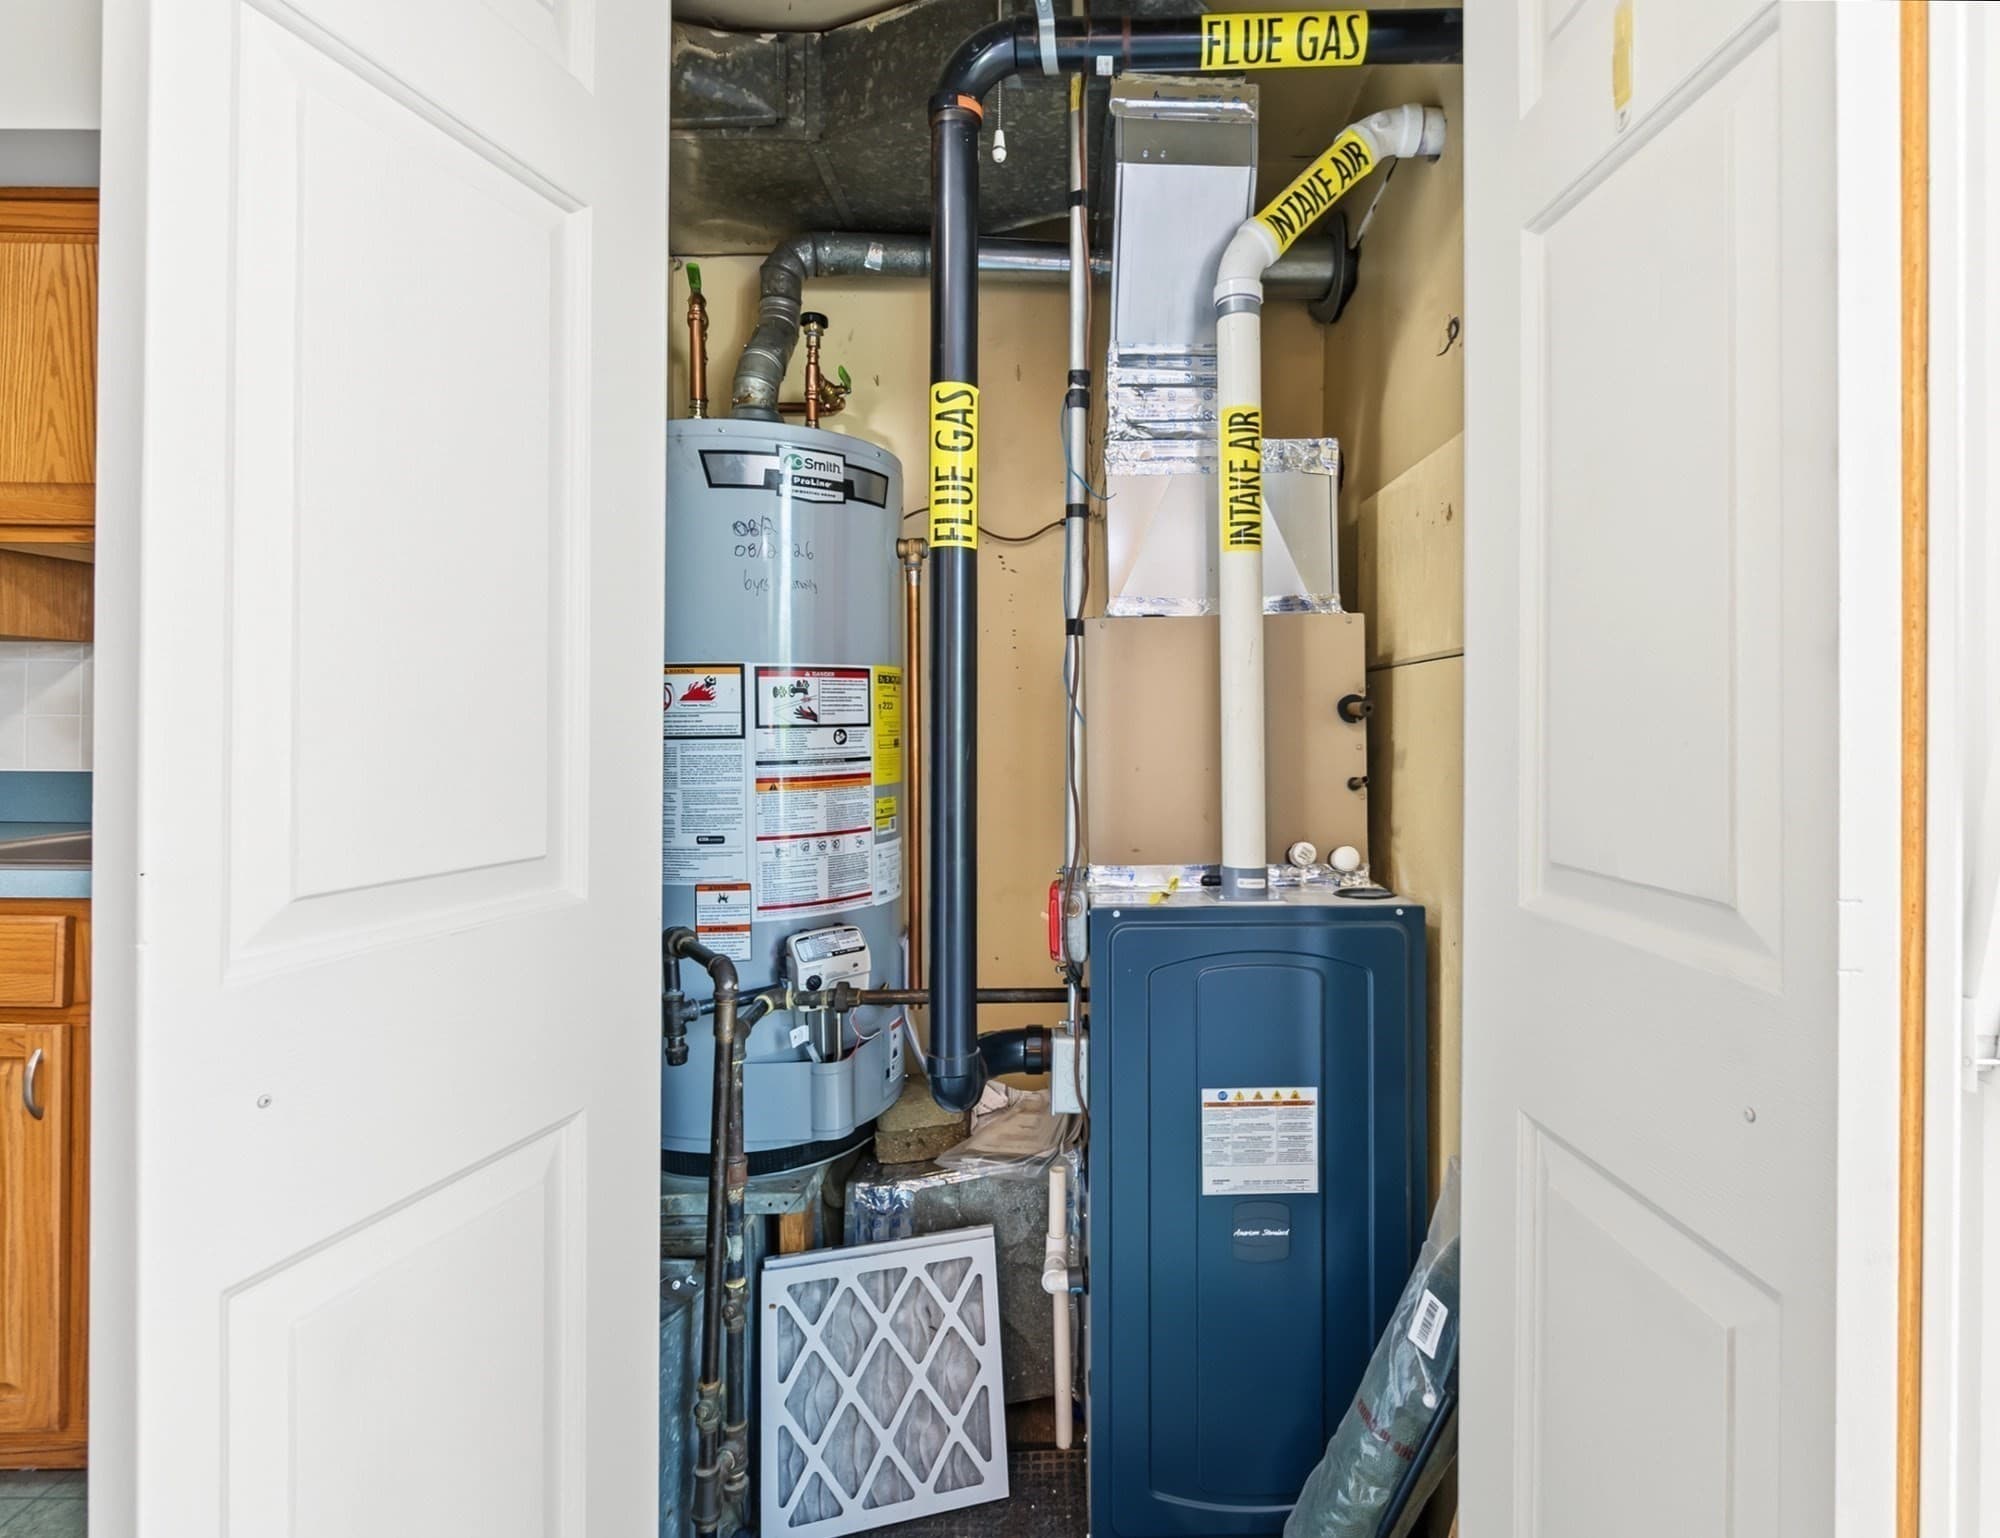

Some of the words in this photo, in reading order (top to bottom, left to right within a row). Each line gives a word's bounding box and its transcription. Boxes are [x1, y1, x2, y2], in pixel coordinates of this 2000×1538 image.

[1207, 18, 1283, 65] FLUE
[1297, 15, 1360, 61] GAS
[1265, 168, 1337, 245] INTAKE
[1330, 141, 1369, 189] AIR
[935, 390, 974, 452] GAS
[1228, 411, 1260, 452] AIR
[804, 457, 842, 474] Smith
[934, 466, 974, 542] FLUE
[1229, 459, 1261, 545] INTAKE
